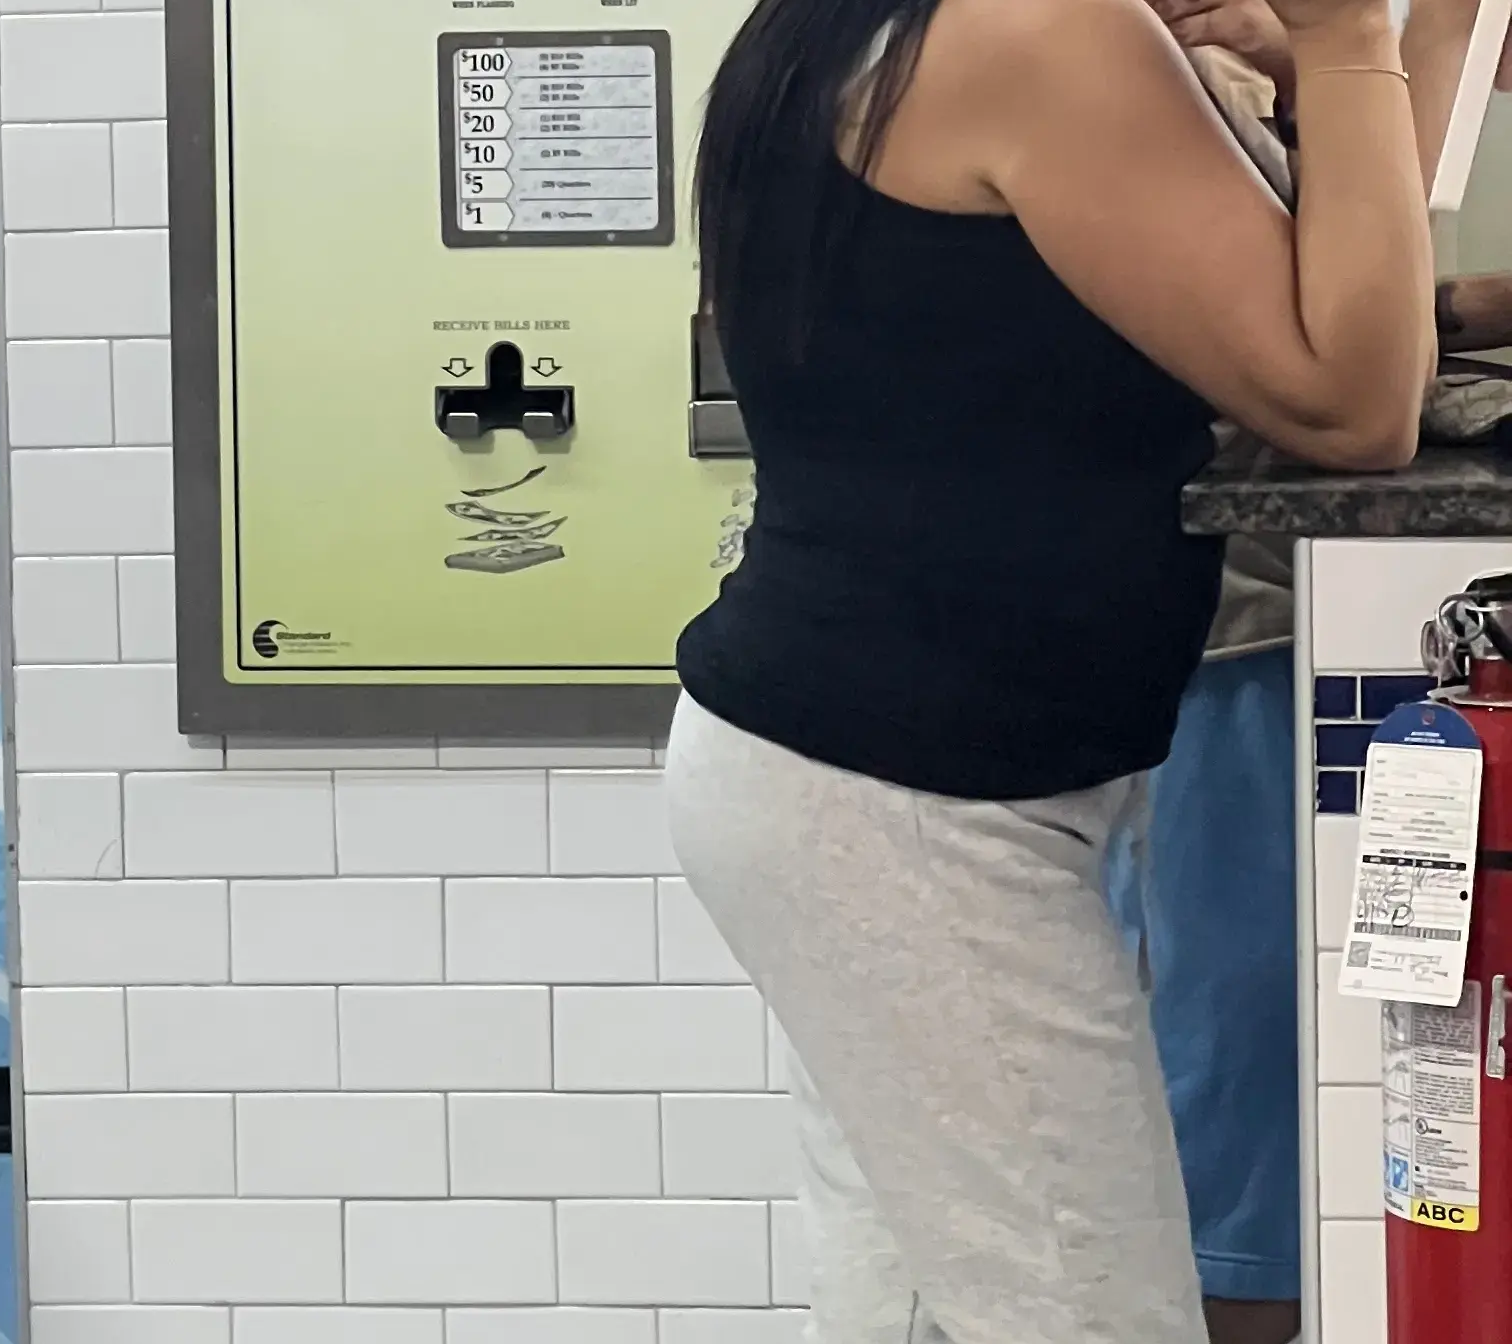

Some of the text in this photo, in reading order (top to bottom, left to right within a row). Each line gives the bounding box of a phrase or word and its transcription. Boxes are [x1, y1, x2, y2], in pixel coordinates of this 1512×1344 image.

[461, 50, 505, 72] $100
[463, 81, 494, 102] $50
[463, 112, 495, 133] $20
[464, 143, 495, 164] $10
[464, 172, 483, 194] $5
[465, 204, 483, 225] $1
[1416, 1206, 1465, 1225] ABC
